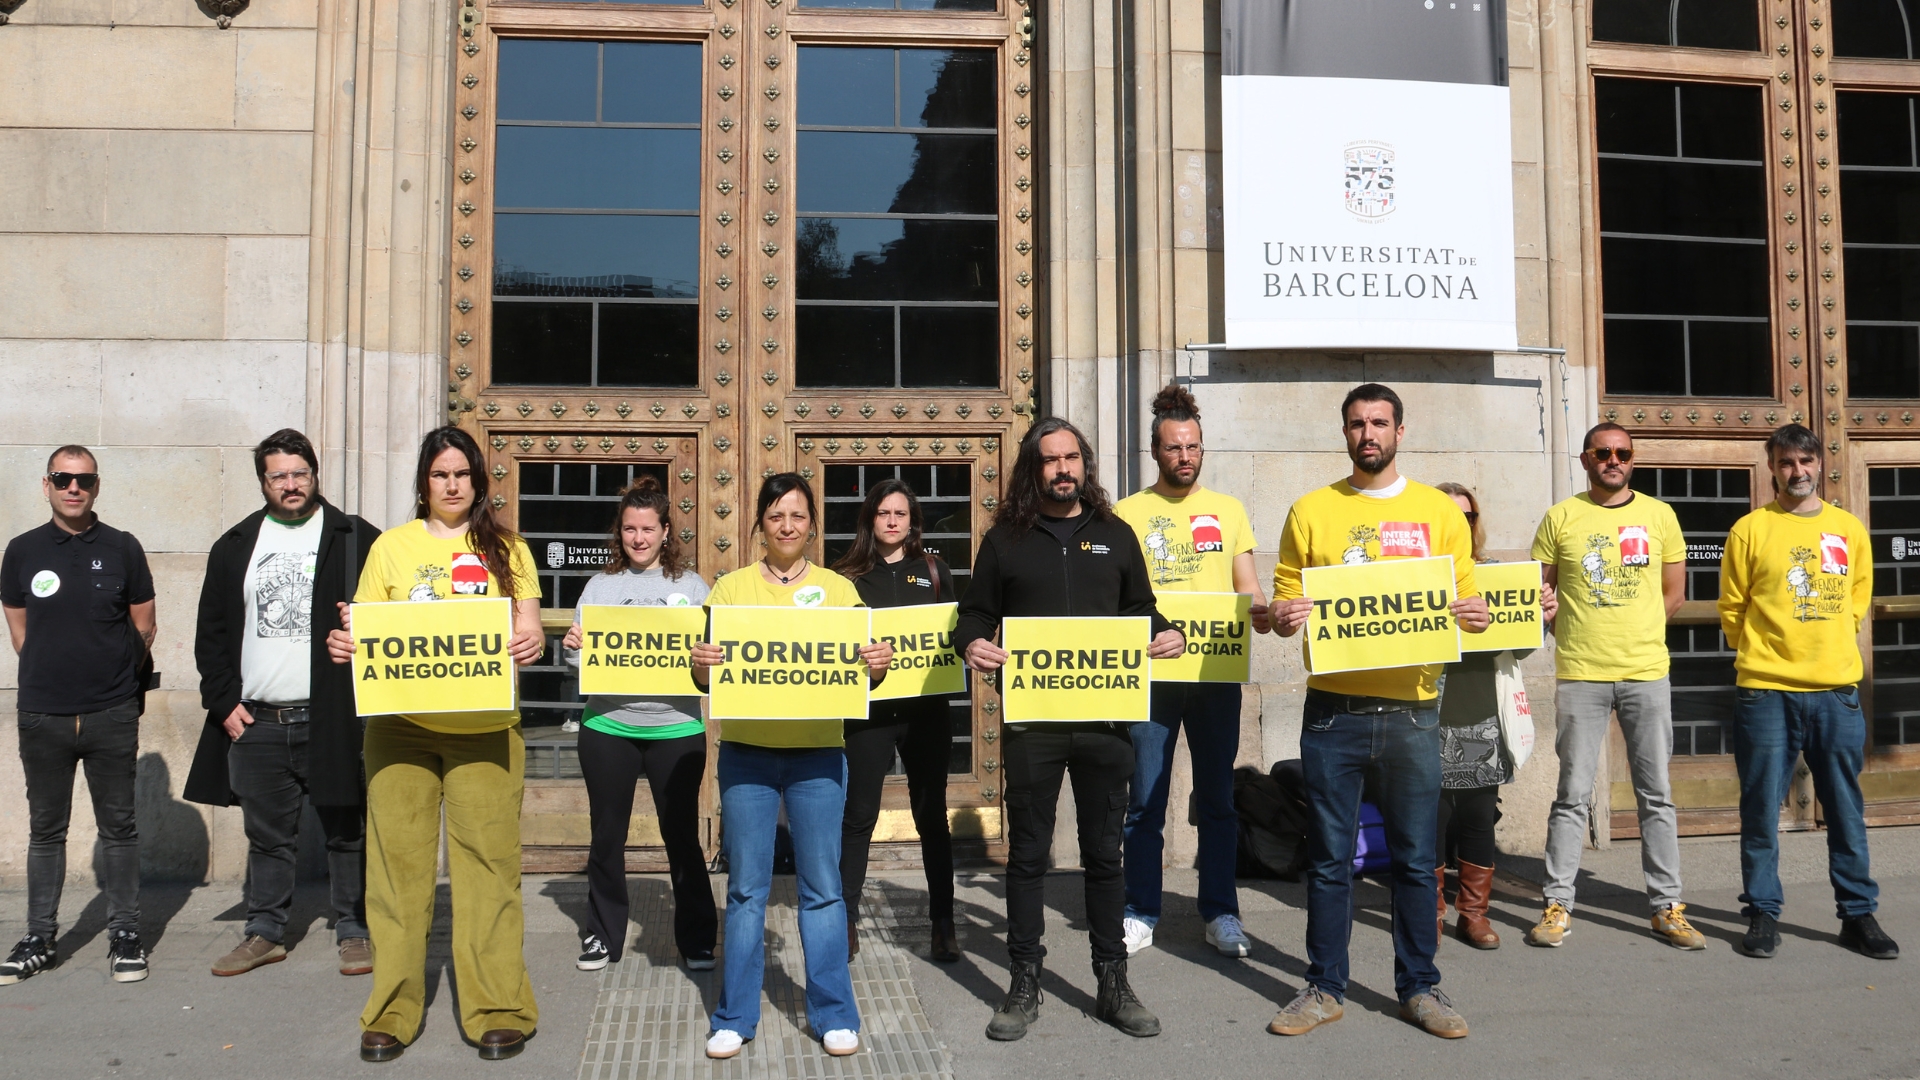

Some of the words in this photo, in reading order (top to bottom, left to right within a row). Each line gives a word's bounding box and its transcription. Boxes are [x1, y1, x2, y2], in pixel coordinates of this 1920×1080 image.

[1263, 241, 1455, 266] UNIVERSITAT
[1262, 273, 1479, 300] BARCELONA
[1382, 530, 1411, 539] INTER
[568, 546, 612, 555] UNIVERSI
[1196, 541, 1222, 552] CGT
[1382, 538, 1429, 550] SINDICAL
[1622, 554, 1649, 565] CGT
[1685, 551, 1724, 560] CELONA
[452, 581, 488, 595] CGT
[1313, 589, 1448, 620] TORNEU
[1485, 589, 1536, 607] NEU
[1489, 610, 1535, 624] OCIAR
[1171, 620, 1245, 639] RNEU
[1316, 626, 1332, 641] A
[1337, 615, 1449, 639] NEGOCIAR
[360, 633, 502, 659] TORNEU
[587, 631, 701, 650] TORNEU
[873, 631, 954, 654] RNEU
[1187, 642, 1243, 656] OCIAR
[587, 654, 600, 666] A
[719, 641, 860, 664] TORNEU
[1011, 650, 1141, 669] TORNEU
[888, 653, 956, 670] GOCIAR
[362, 665, 378, 681] A
[385, 661, 503, 680] NEGOCIAR
[719, 669, 734, 684] A
[741, 669, 859, 685] NEGOCIAR
[1011, 675, 1025, 689] A
[1031, 674, 1140, 690] NEGOCIAR
